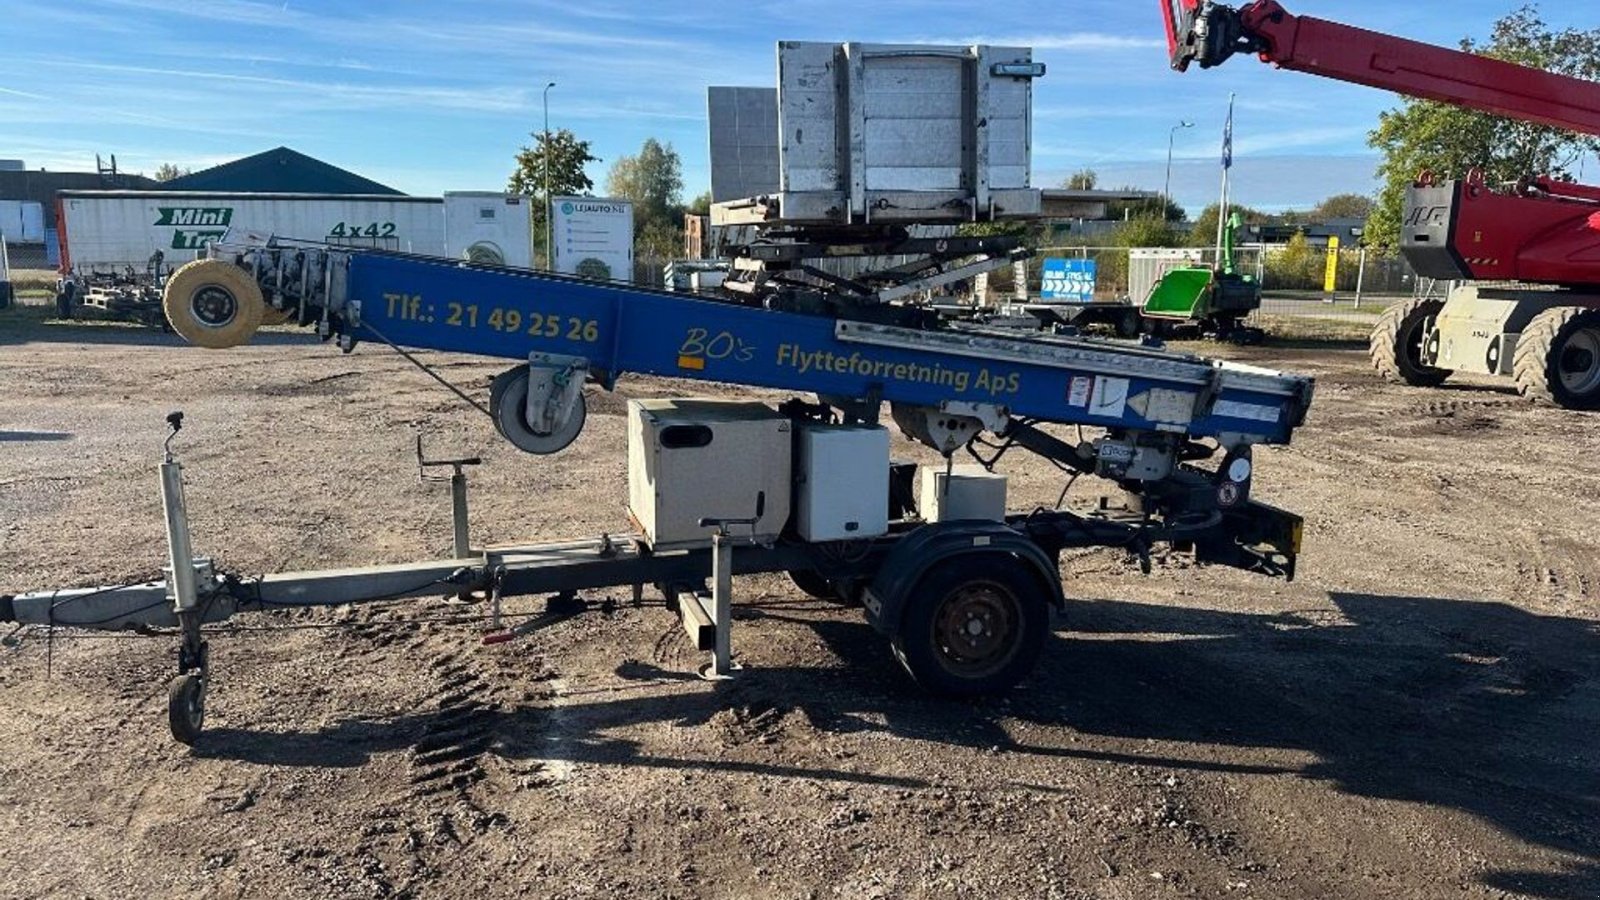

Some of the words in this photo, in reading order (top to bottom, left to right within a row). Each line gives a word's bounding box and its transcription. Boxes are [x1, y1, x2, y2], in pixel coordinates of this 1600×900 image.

[170, 208, 226, 225] Mini
[1404, 205, 1448, 226] JLG
[329, 221, 396, 238] 4x42
[383, 293, 435, 323] Tlf.:
[446, 302, 478, 328] 21
[487, 307, 522, 333] 49
[527, 312, 560, 337] 25
[566, 317, 599, 342] 26
[776, 343, 970, 392] Flytteforretning
[974, 368, 1020, 396] ApS
